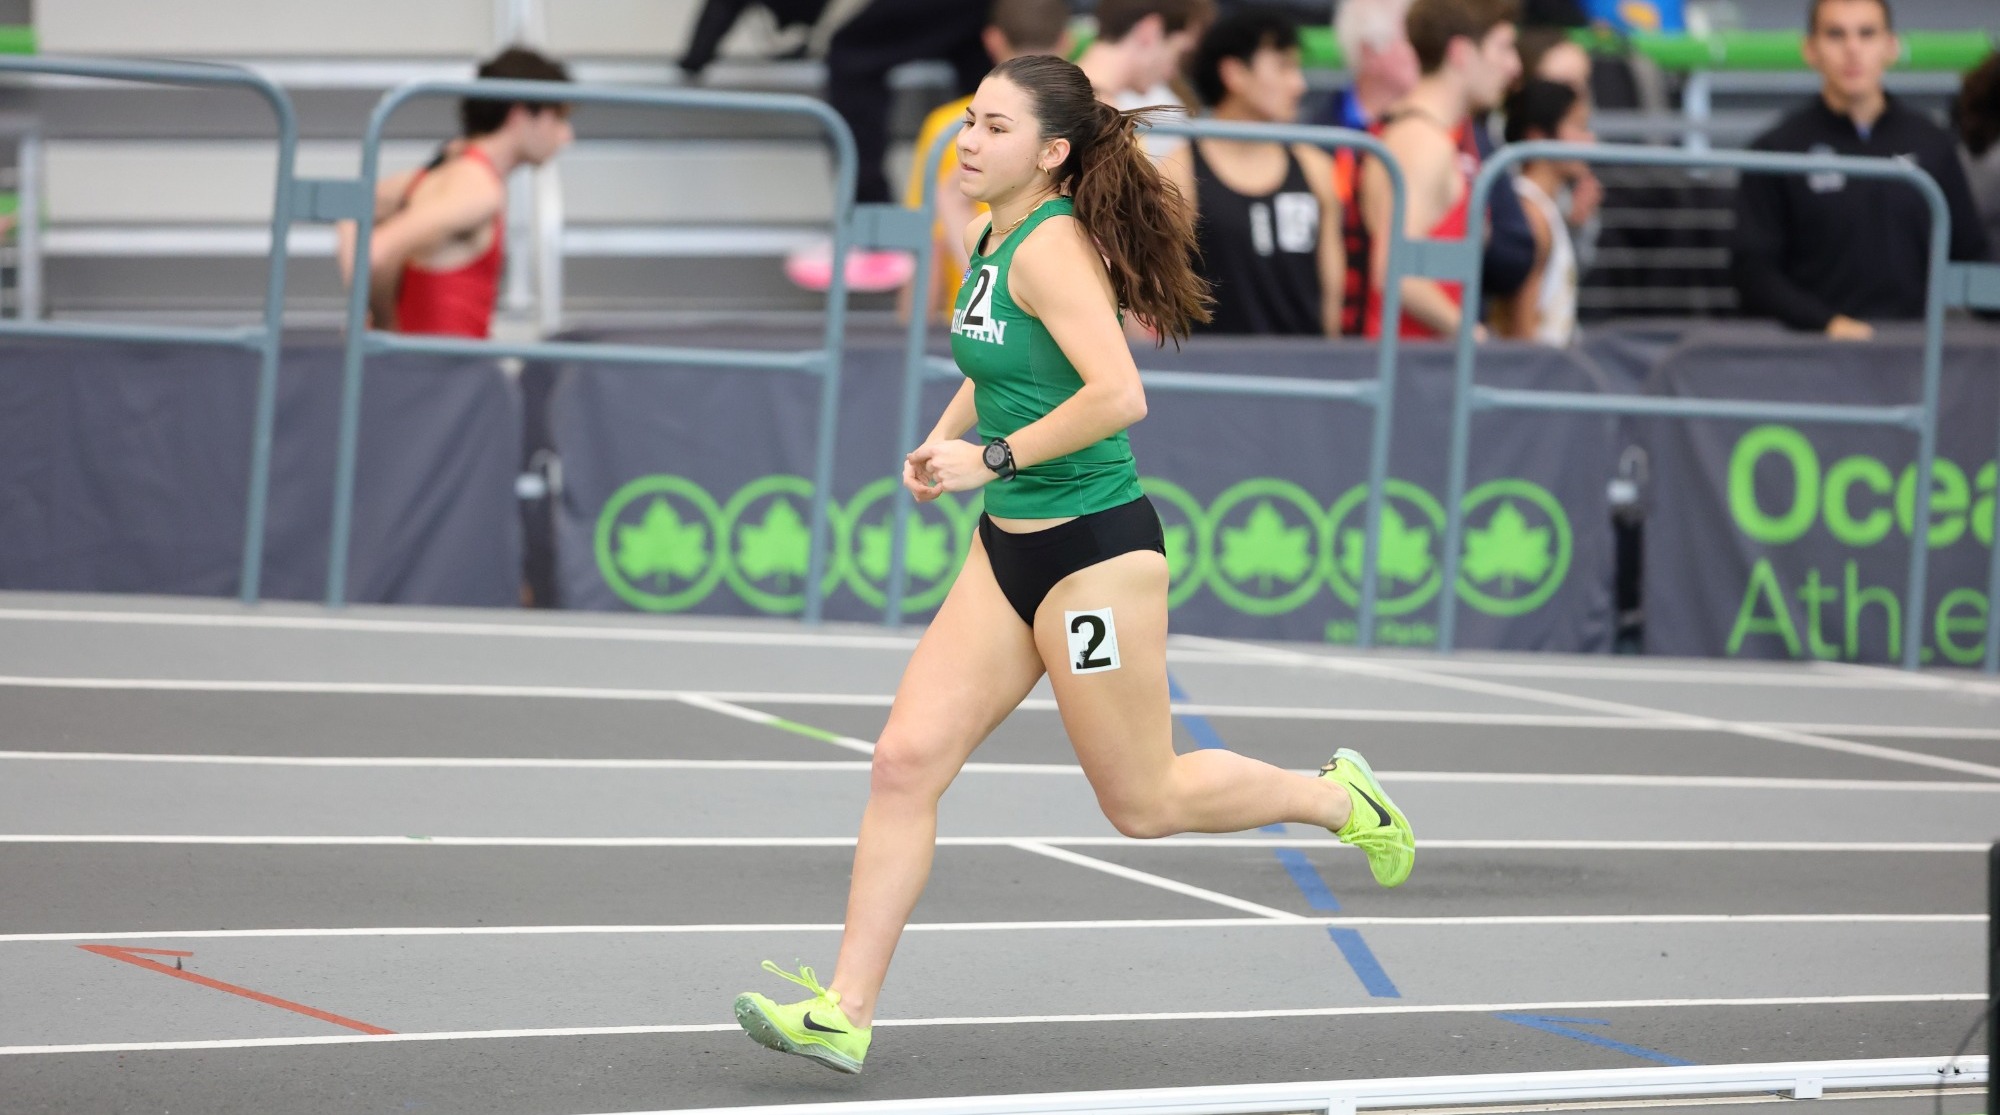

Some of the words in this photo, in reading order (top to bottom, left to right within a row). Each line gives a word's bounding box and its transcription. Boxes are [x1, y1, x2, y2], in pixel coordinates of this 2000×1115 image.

[963, 268, 991, 326] 2
[1726, 557, 1989, 665] Athe
[1070, 614, 1112, 669] 2
